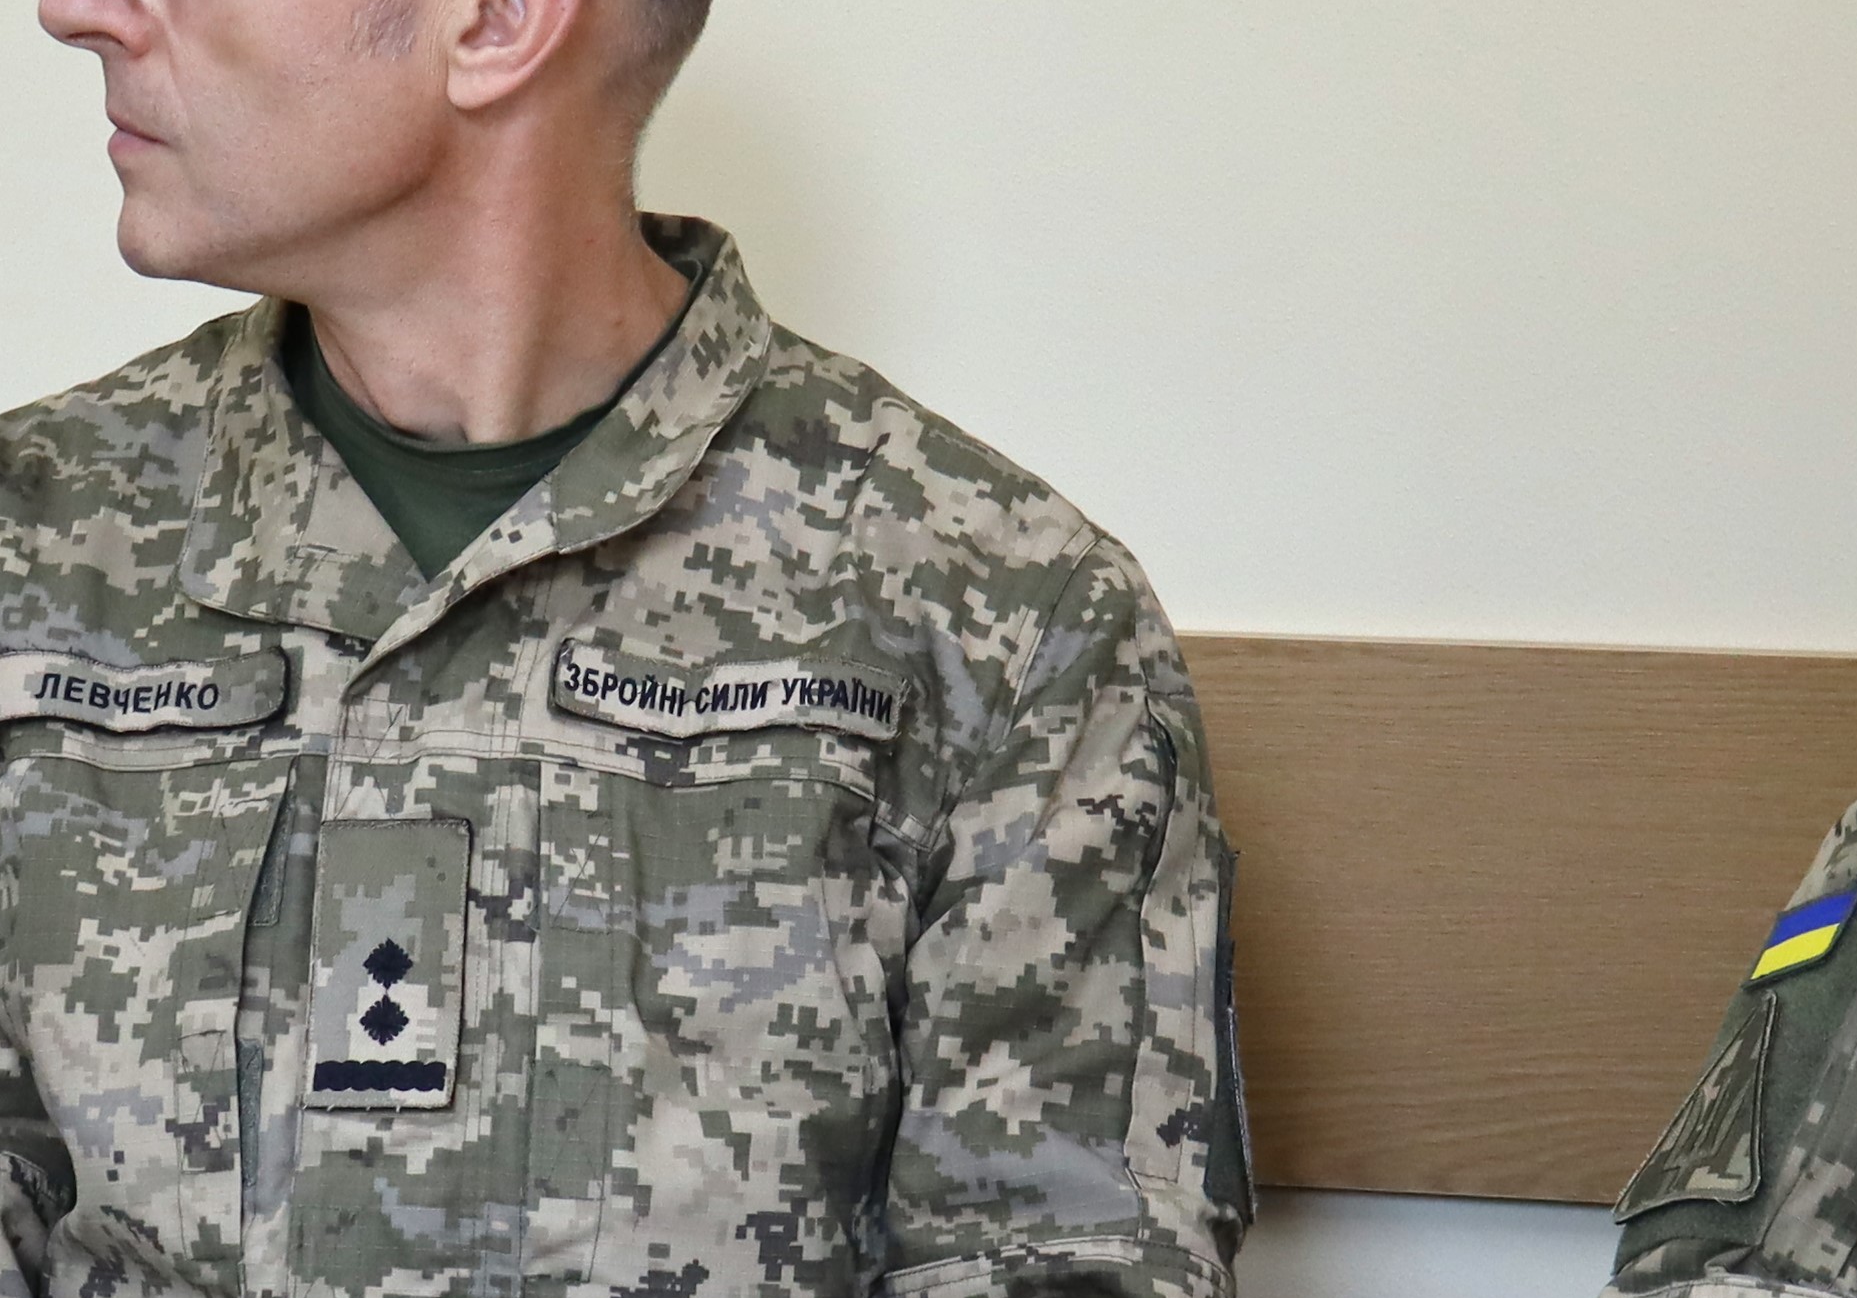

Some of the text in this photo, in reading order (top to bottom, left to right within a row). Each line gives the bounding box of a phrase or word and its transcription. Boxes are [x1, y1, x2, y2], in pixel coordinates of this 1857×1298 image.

[34, 672, 220, 715] ЛЕВЧЕНКО
[564, 662, 893, 724] ЗБРОЙНІ СИЛИ УКРАЇНИ
